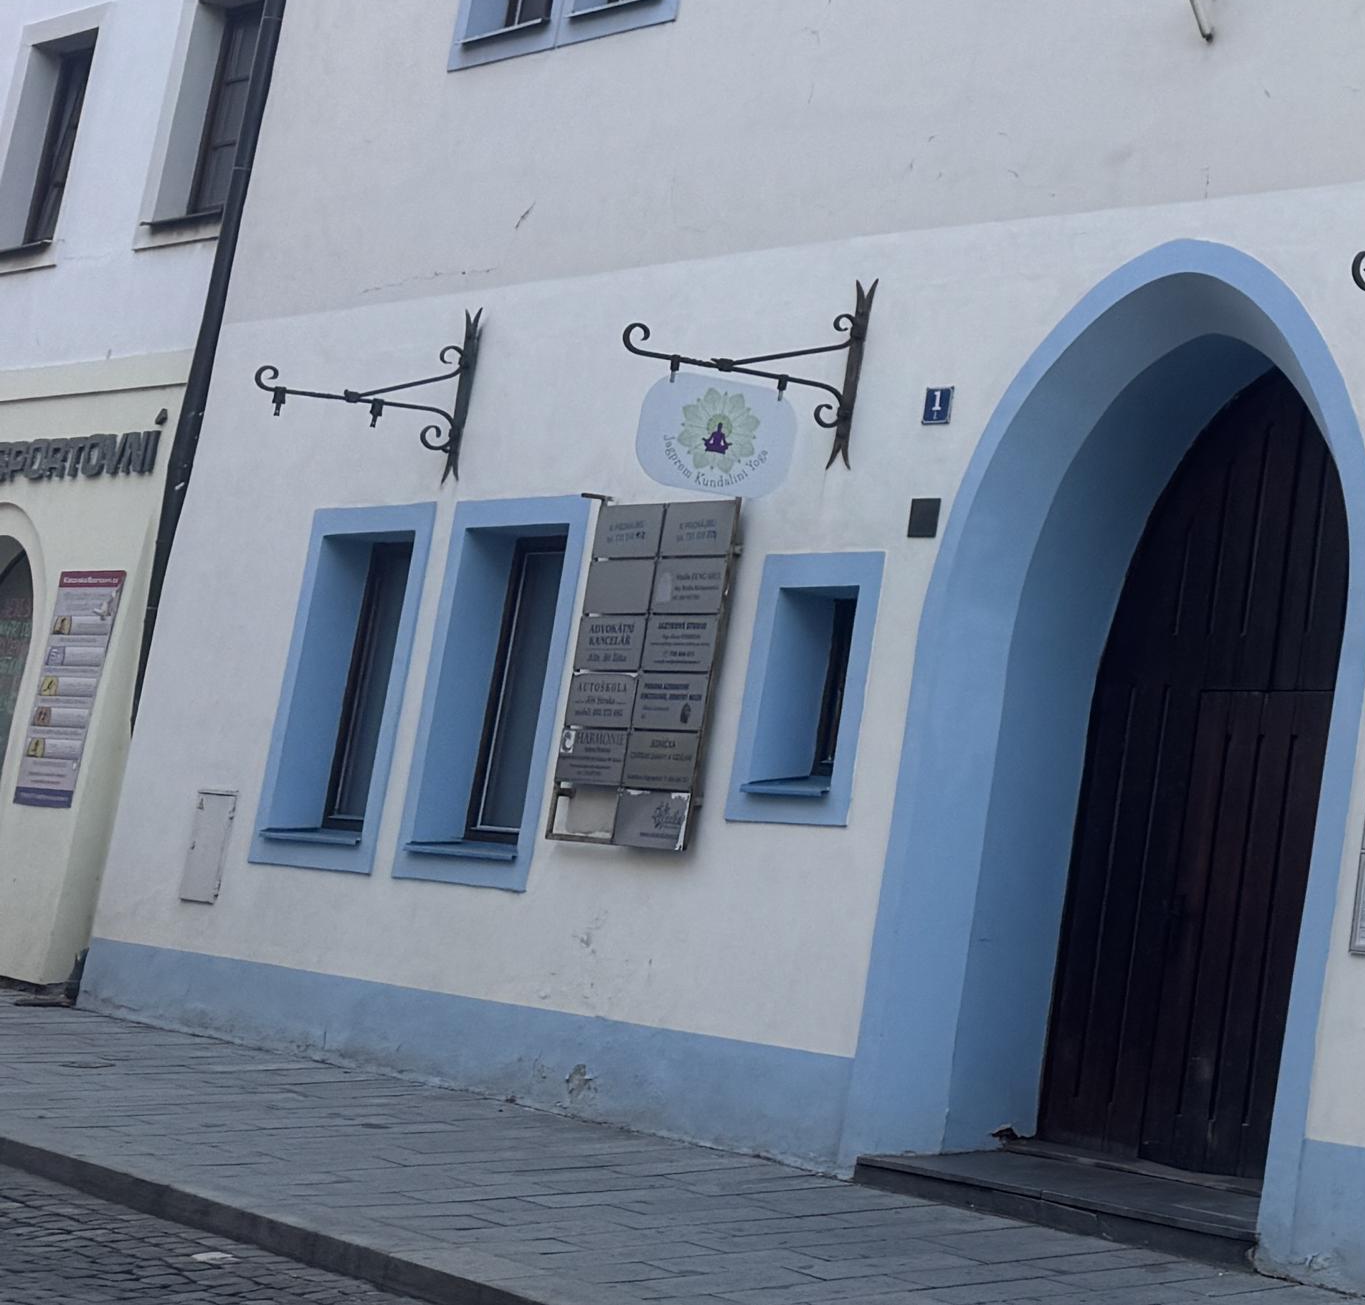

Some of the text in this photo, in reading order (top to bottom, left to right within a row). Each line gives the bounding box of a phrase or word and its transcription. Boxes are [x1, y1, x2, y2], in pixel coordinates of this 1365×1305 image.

[931, 390, 942, 411] 1
[694, 469, 749, 488] Kundalini
[745, 450, 769, 471] Yoga
